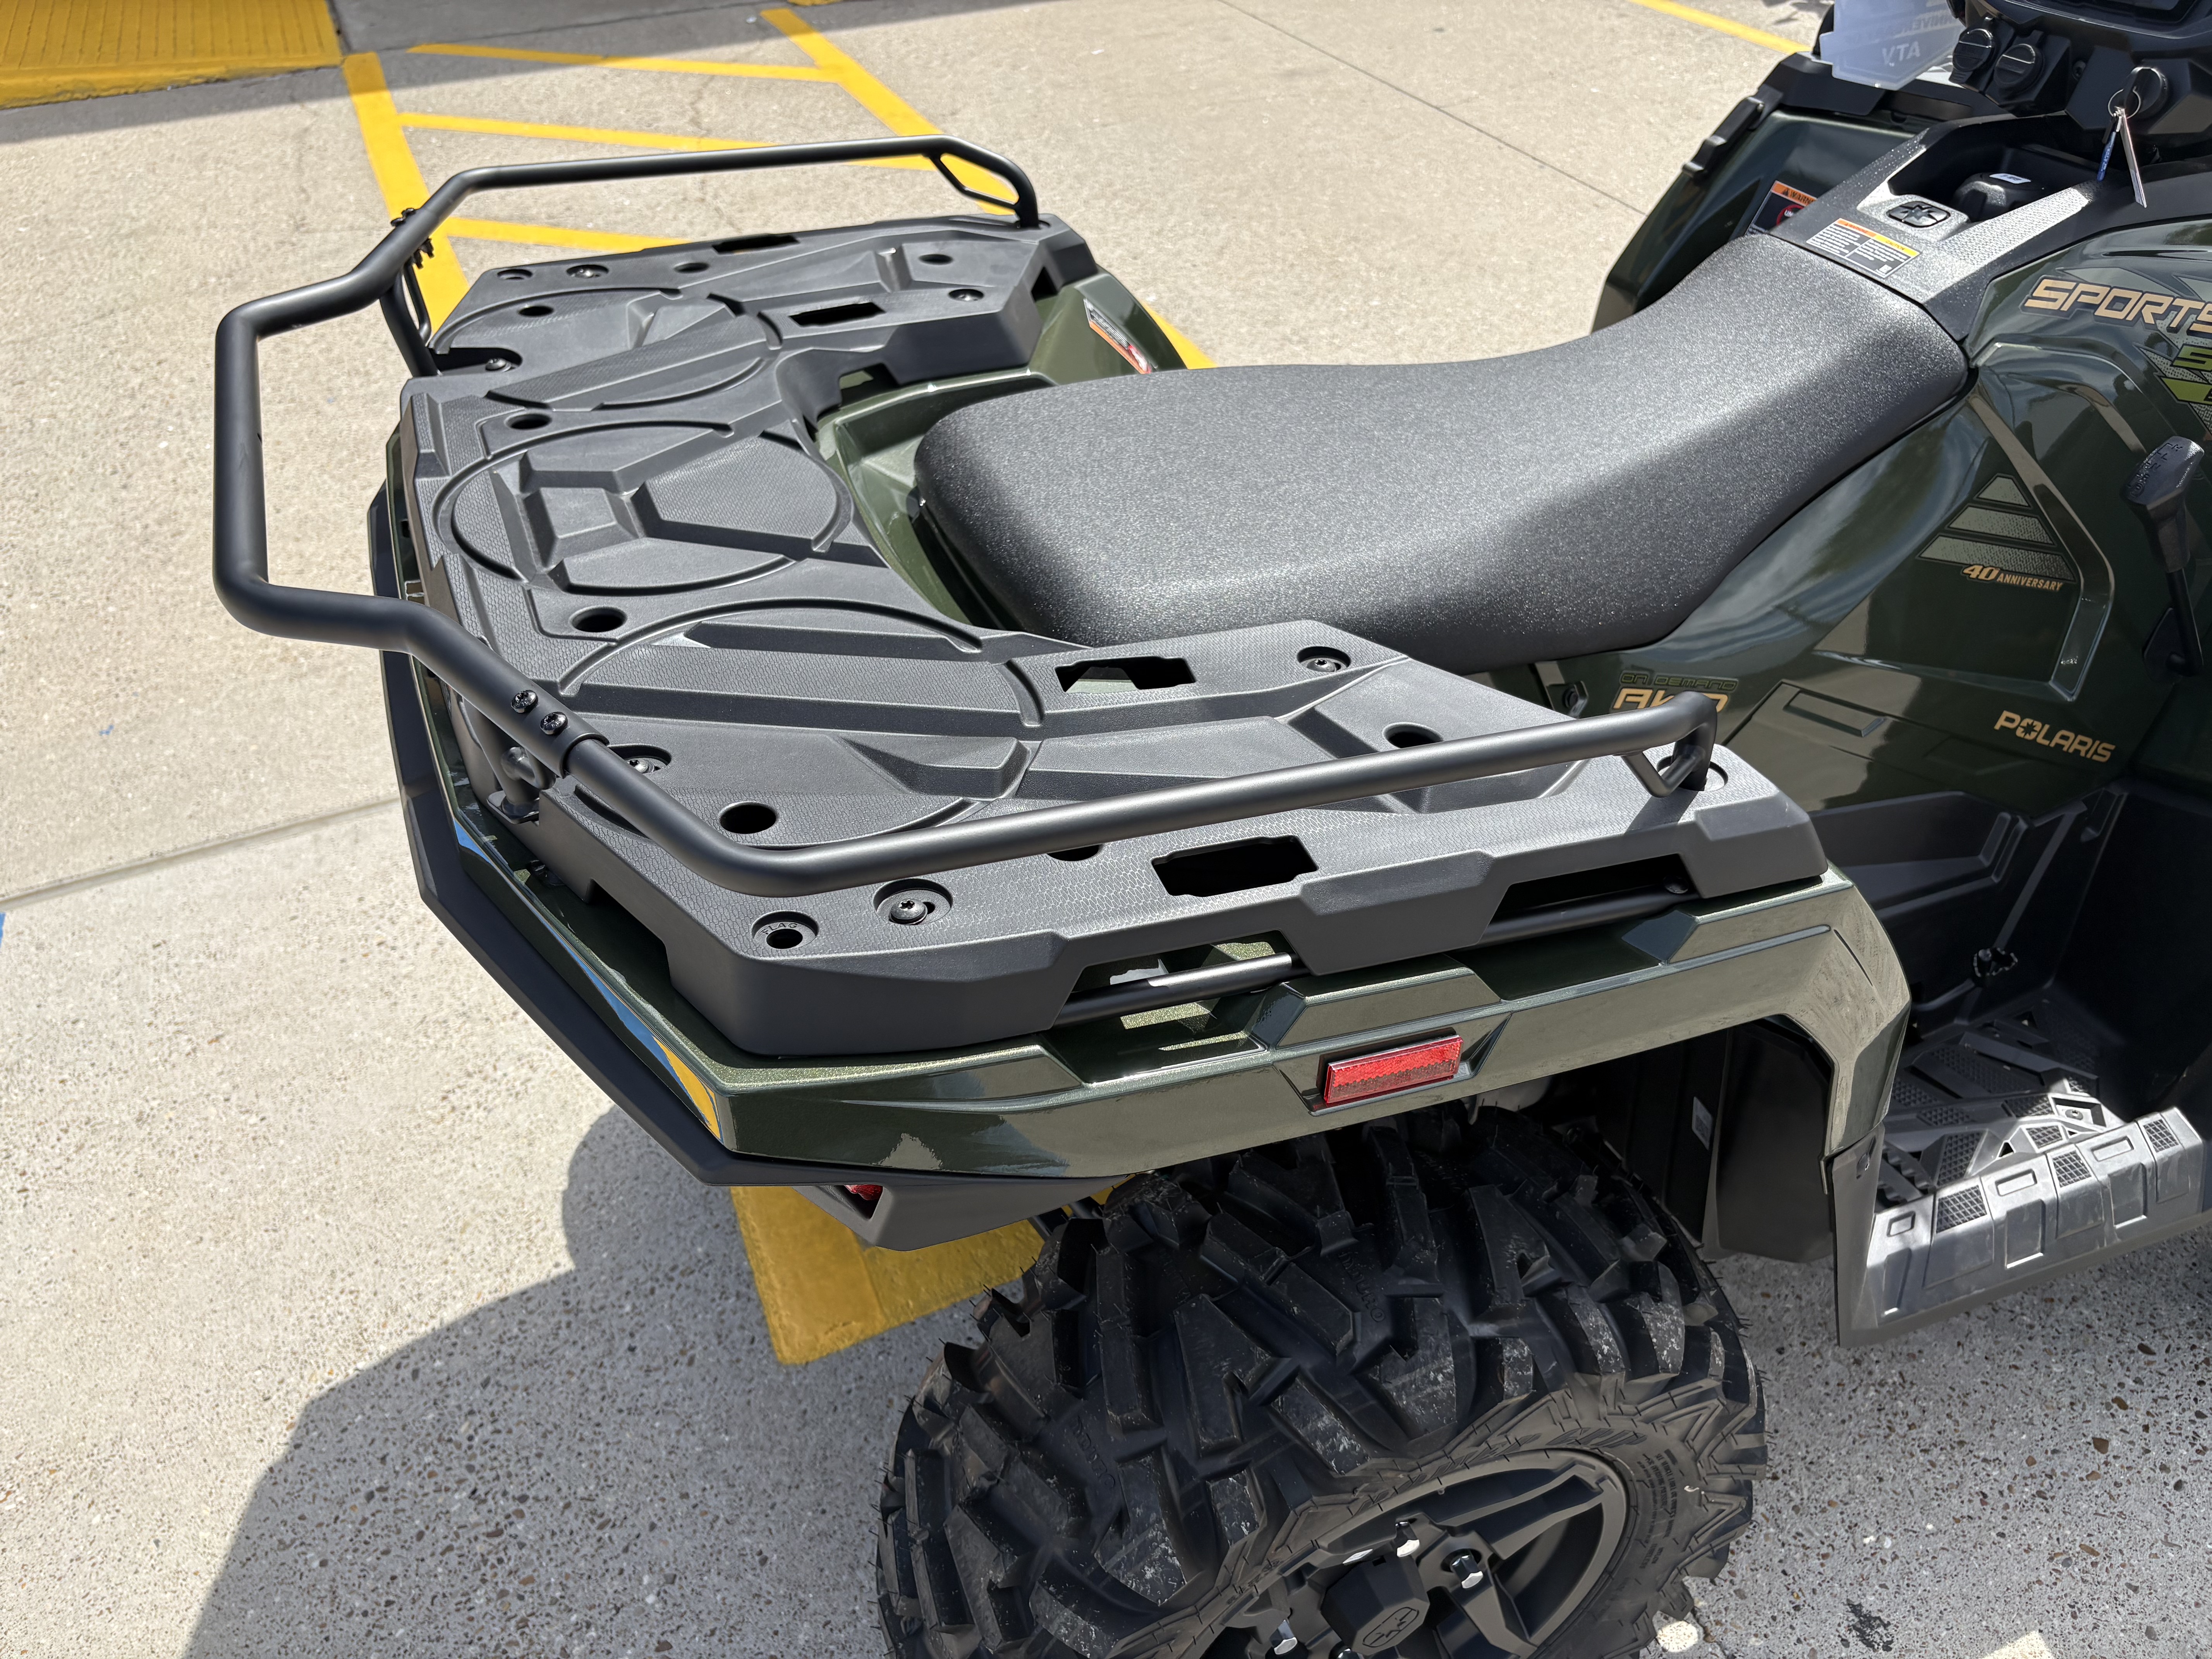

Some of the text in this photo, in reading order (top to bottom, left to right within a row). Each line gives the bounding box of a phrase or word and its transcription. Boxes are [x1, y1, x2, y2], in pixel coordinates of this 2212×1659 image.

[1885, 240, 1905, 251] CAUTION
[1997, 573, 2063, 591] ANNIVERSARY
[1621, 673, 1736, 690] ON DEMAND
[1994, 710, 2116, 763] POLARIS
[761, 923, 797, 934] FLAG
